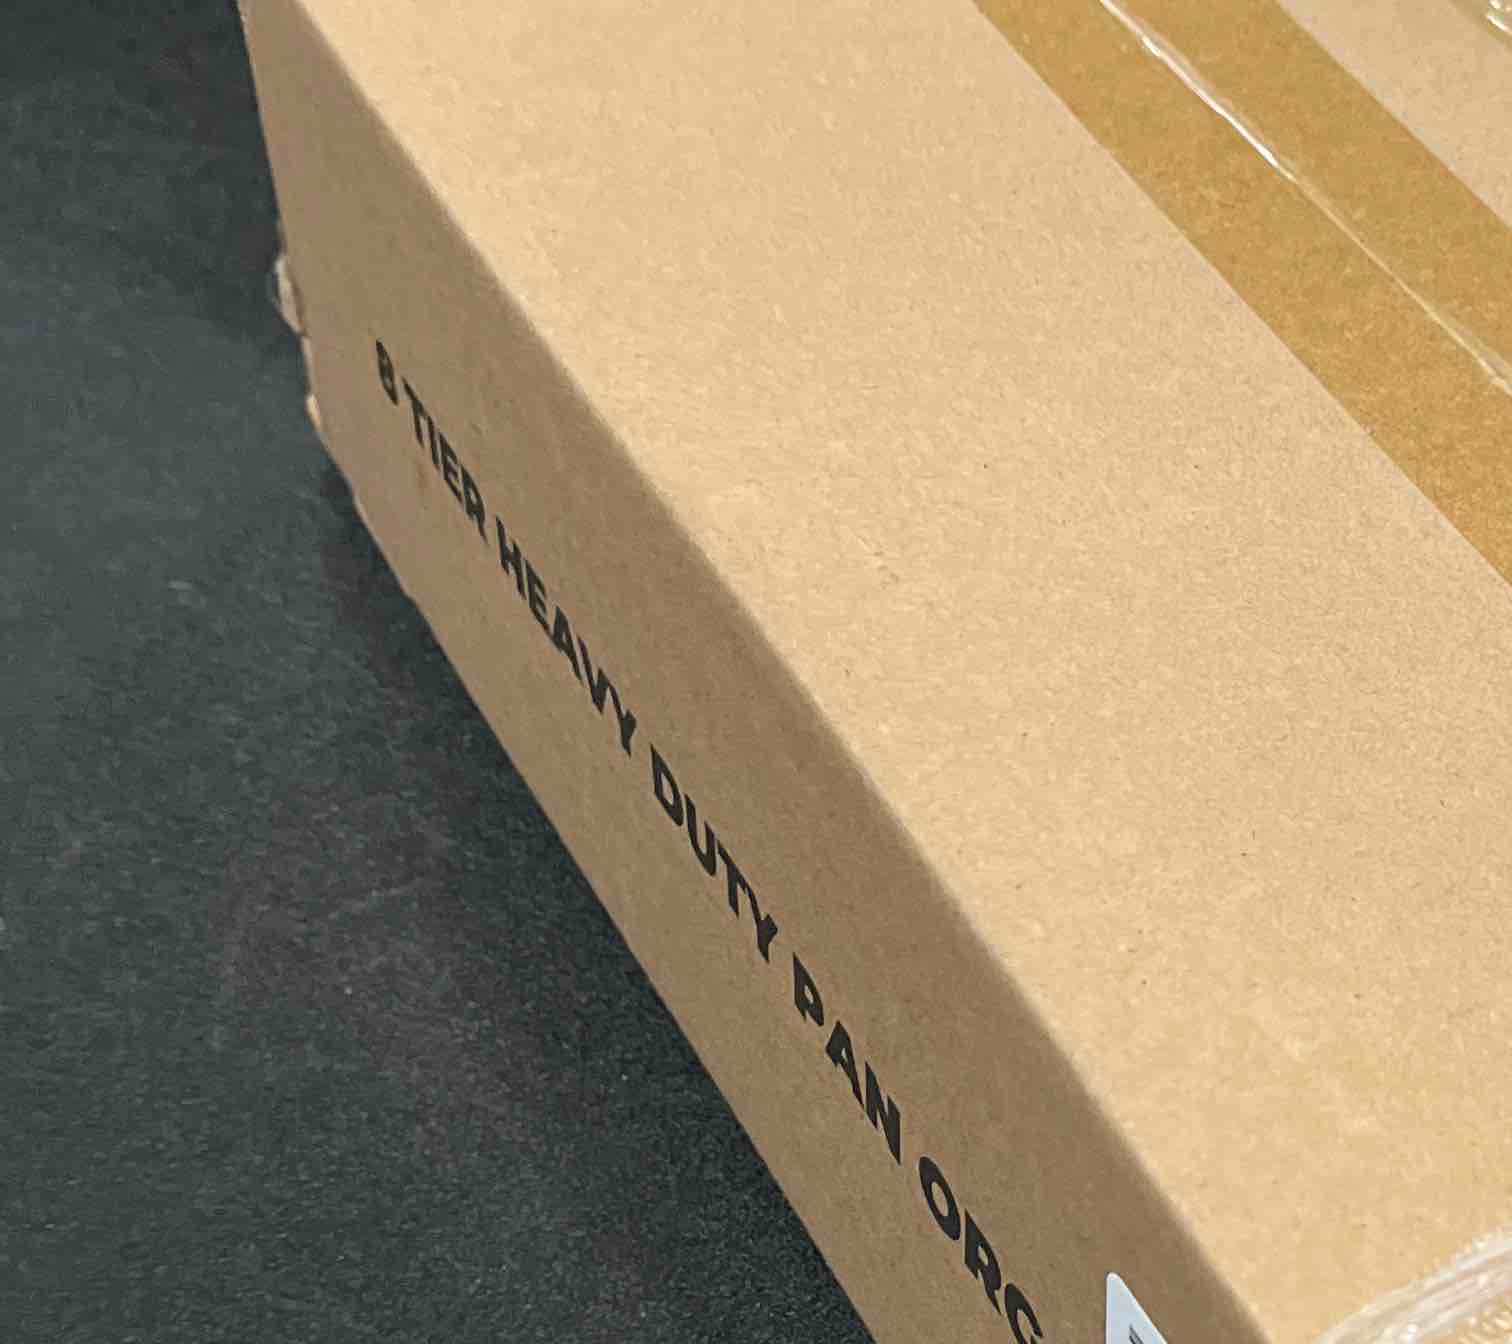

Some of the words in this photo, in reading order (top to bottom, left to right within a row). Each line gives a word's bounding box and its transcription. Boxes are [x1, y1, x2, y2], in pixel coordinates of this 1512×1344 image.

[375, 339, 399, 406] 8
[401, 375, 489, 545] TIER
[495, 514, 637, 758] HEAVY
[650, 742, 779, 964] DUTY
[793, 951, 901, 1167] PAN
